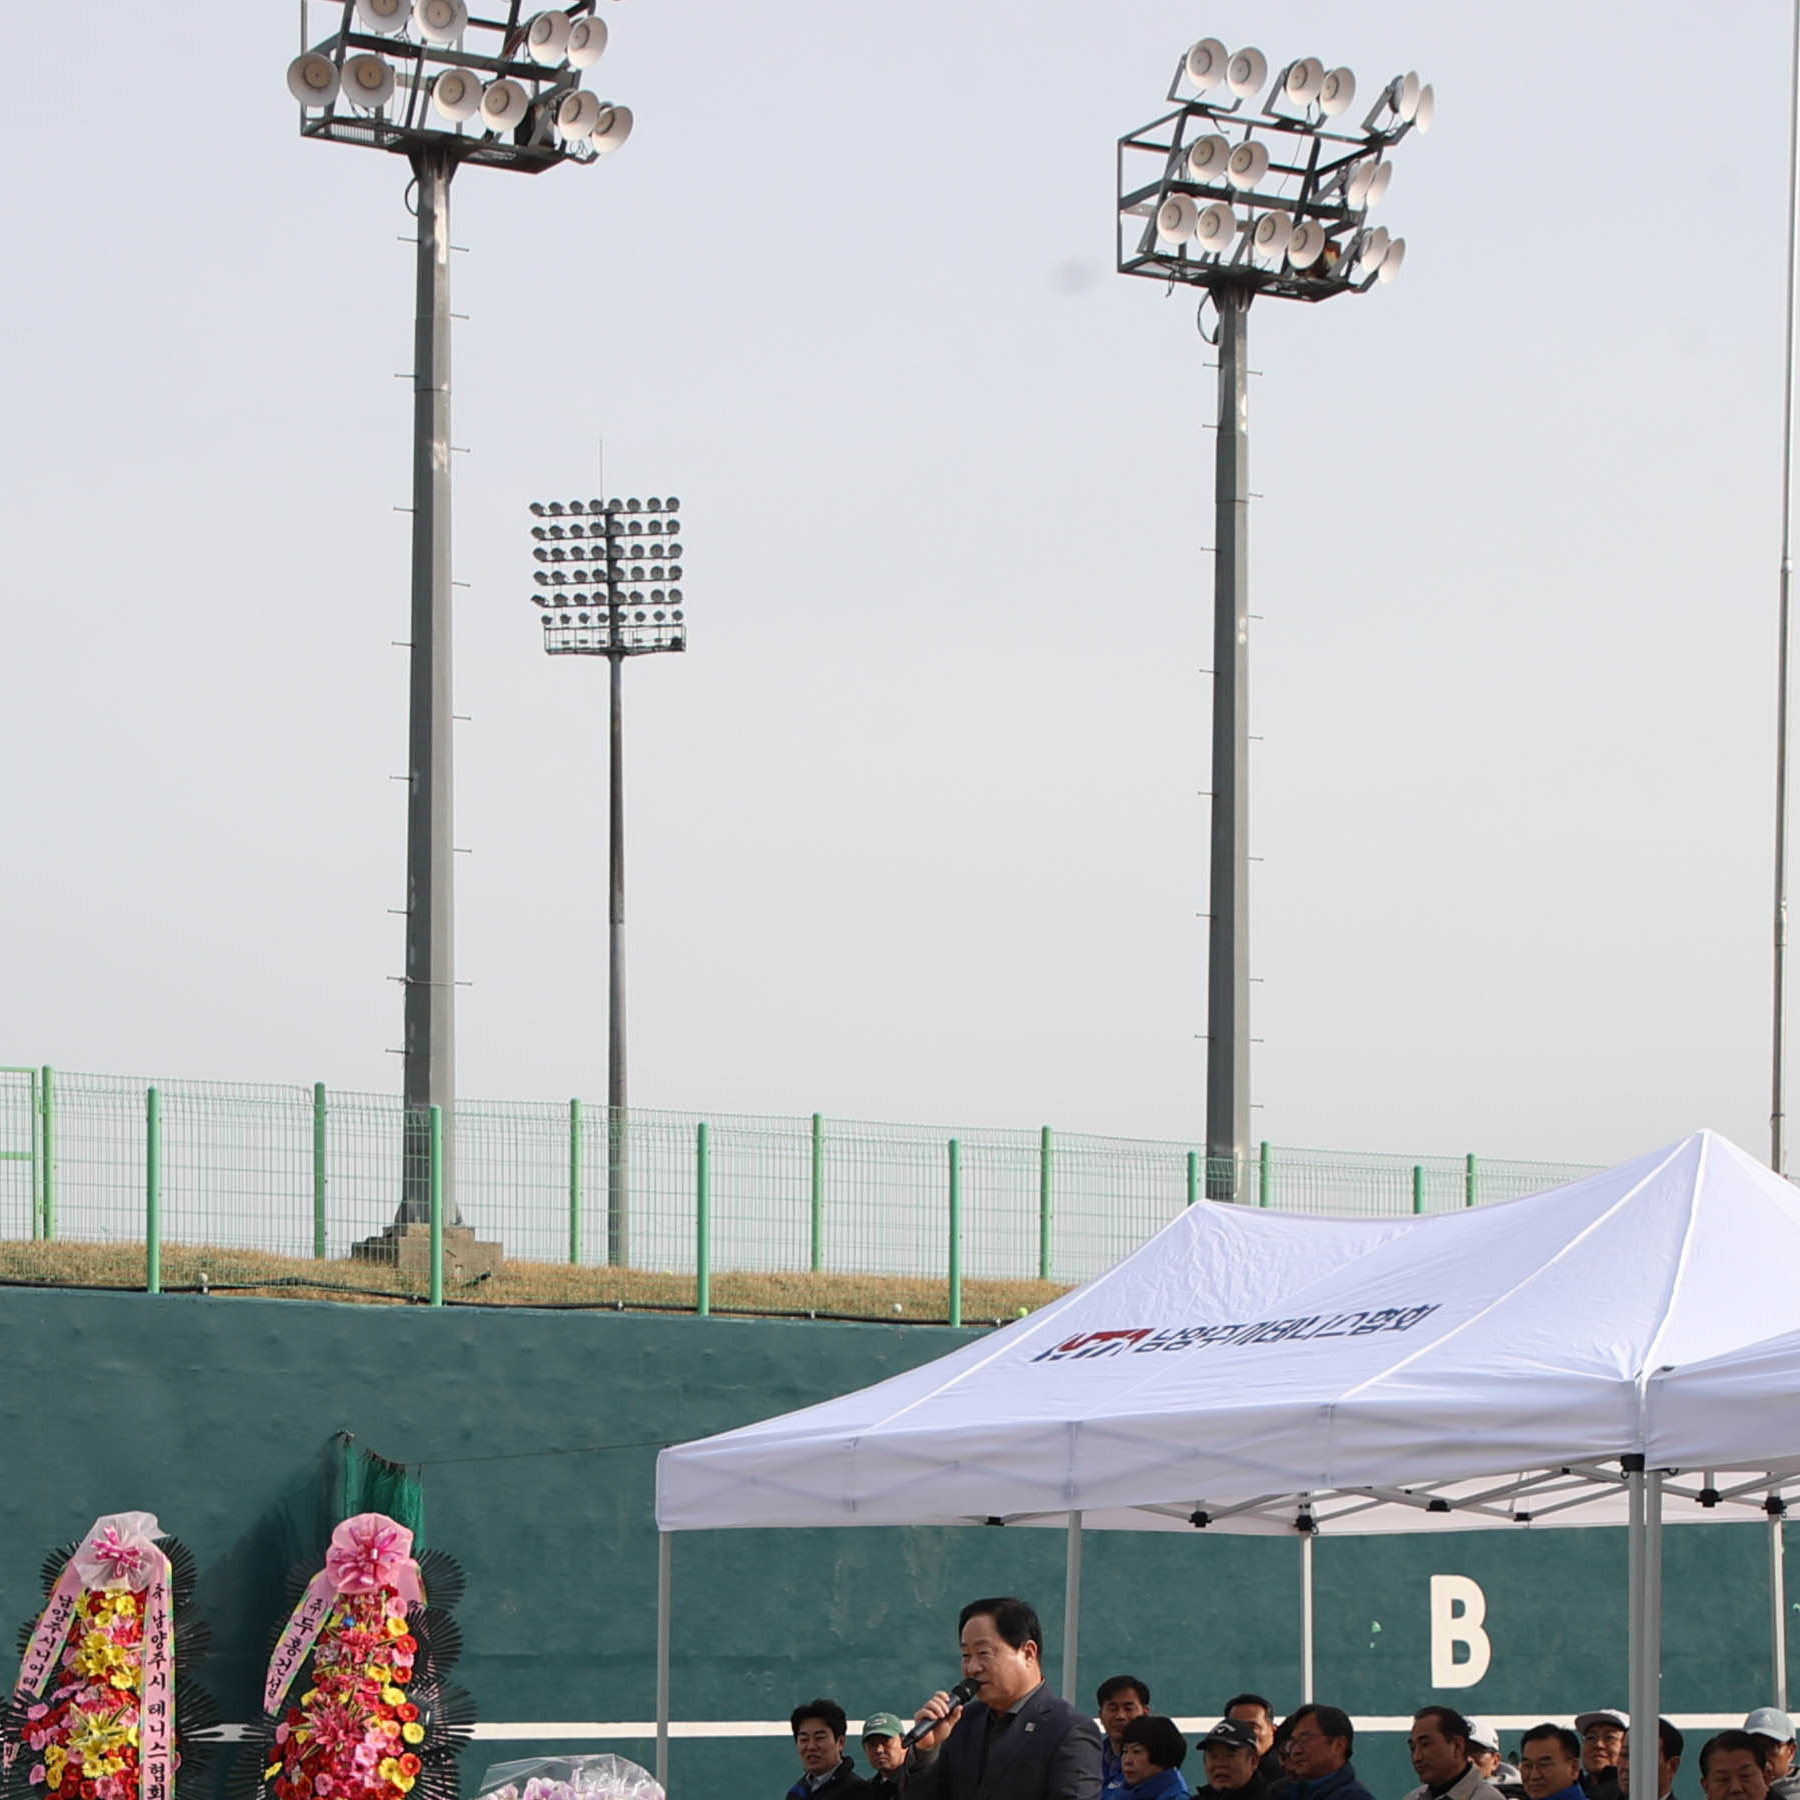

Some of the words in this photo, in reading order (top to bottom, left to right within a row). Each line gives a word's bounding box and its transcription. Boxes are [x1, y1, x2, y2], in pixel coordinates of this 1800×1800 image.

[1133, 1301, 1443, 1354] 남양주시테니스협회
[146, 1610, 168, 1692] 남양주시
[1428, 1573, 1493, 1690] B
